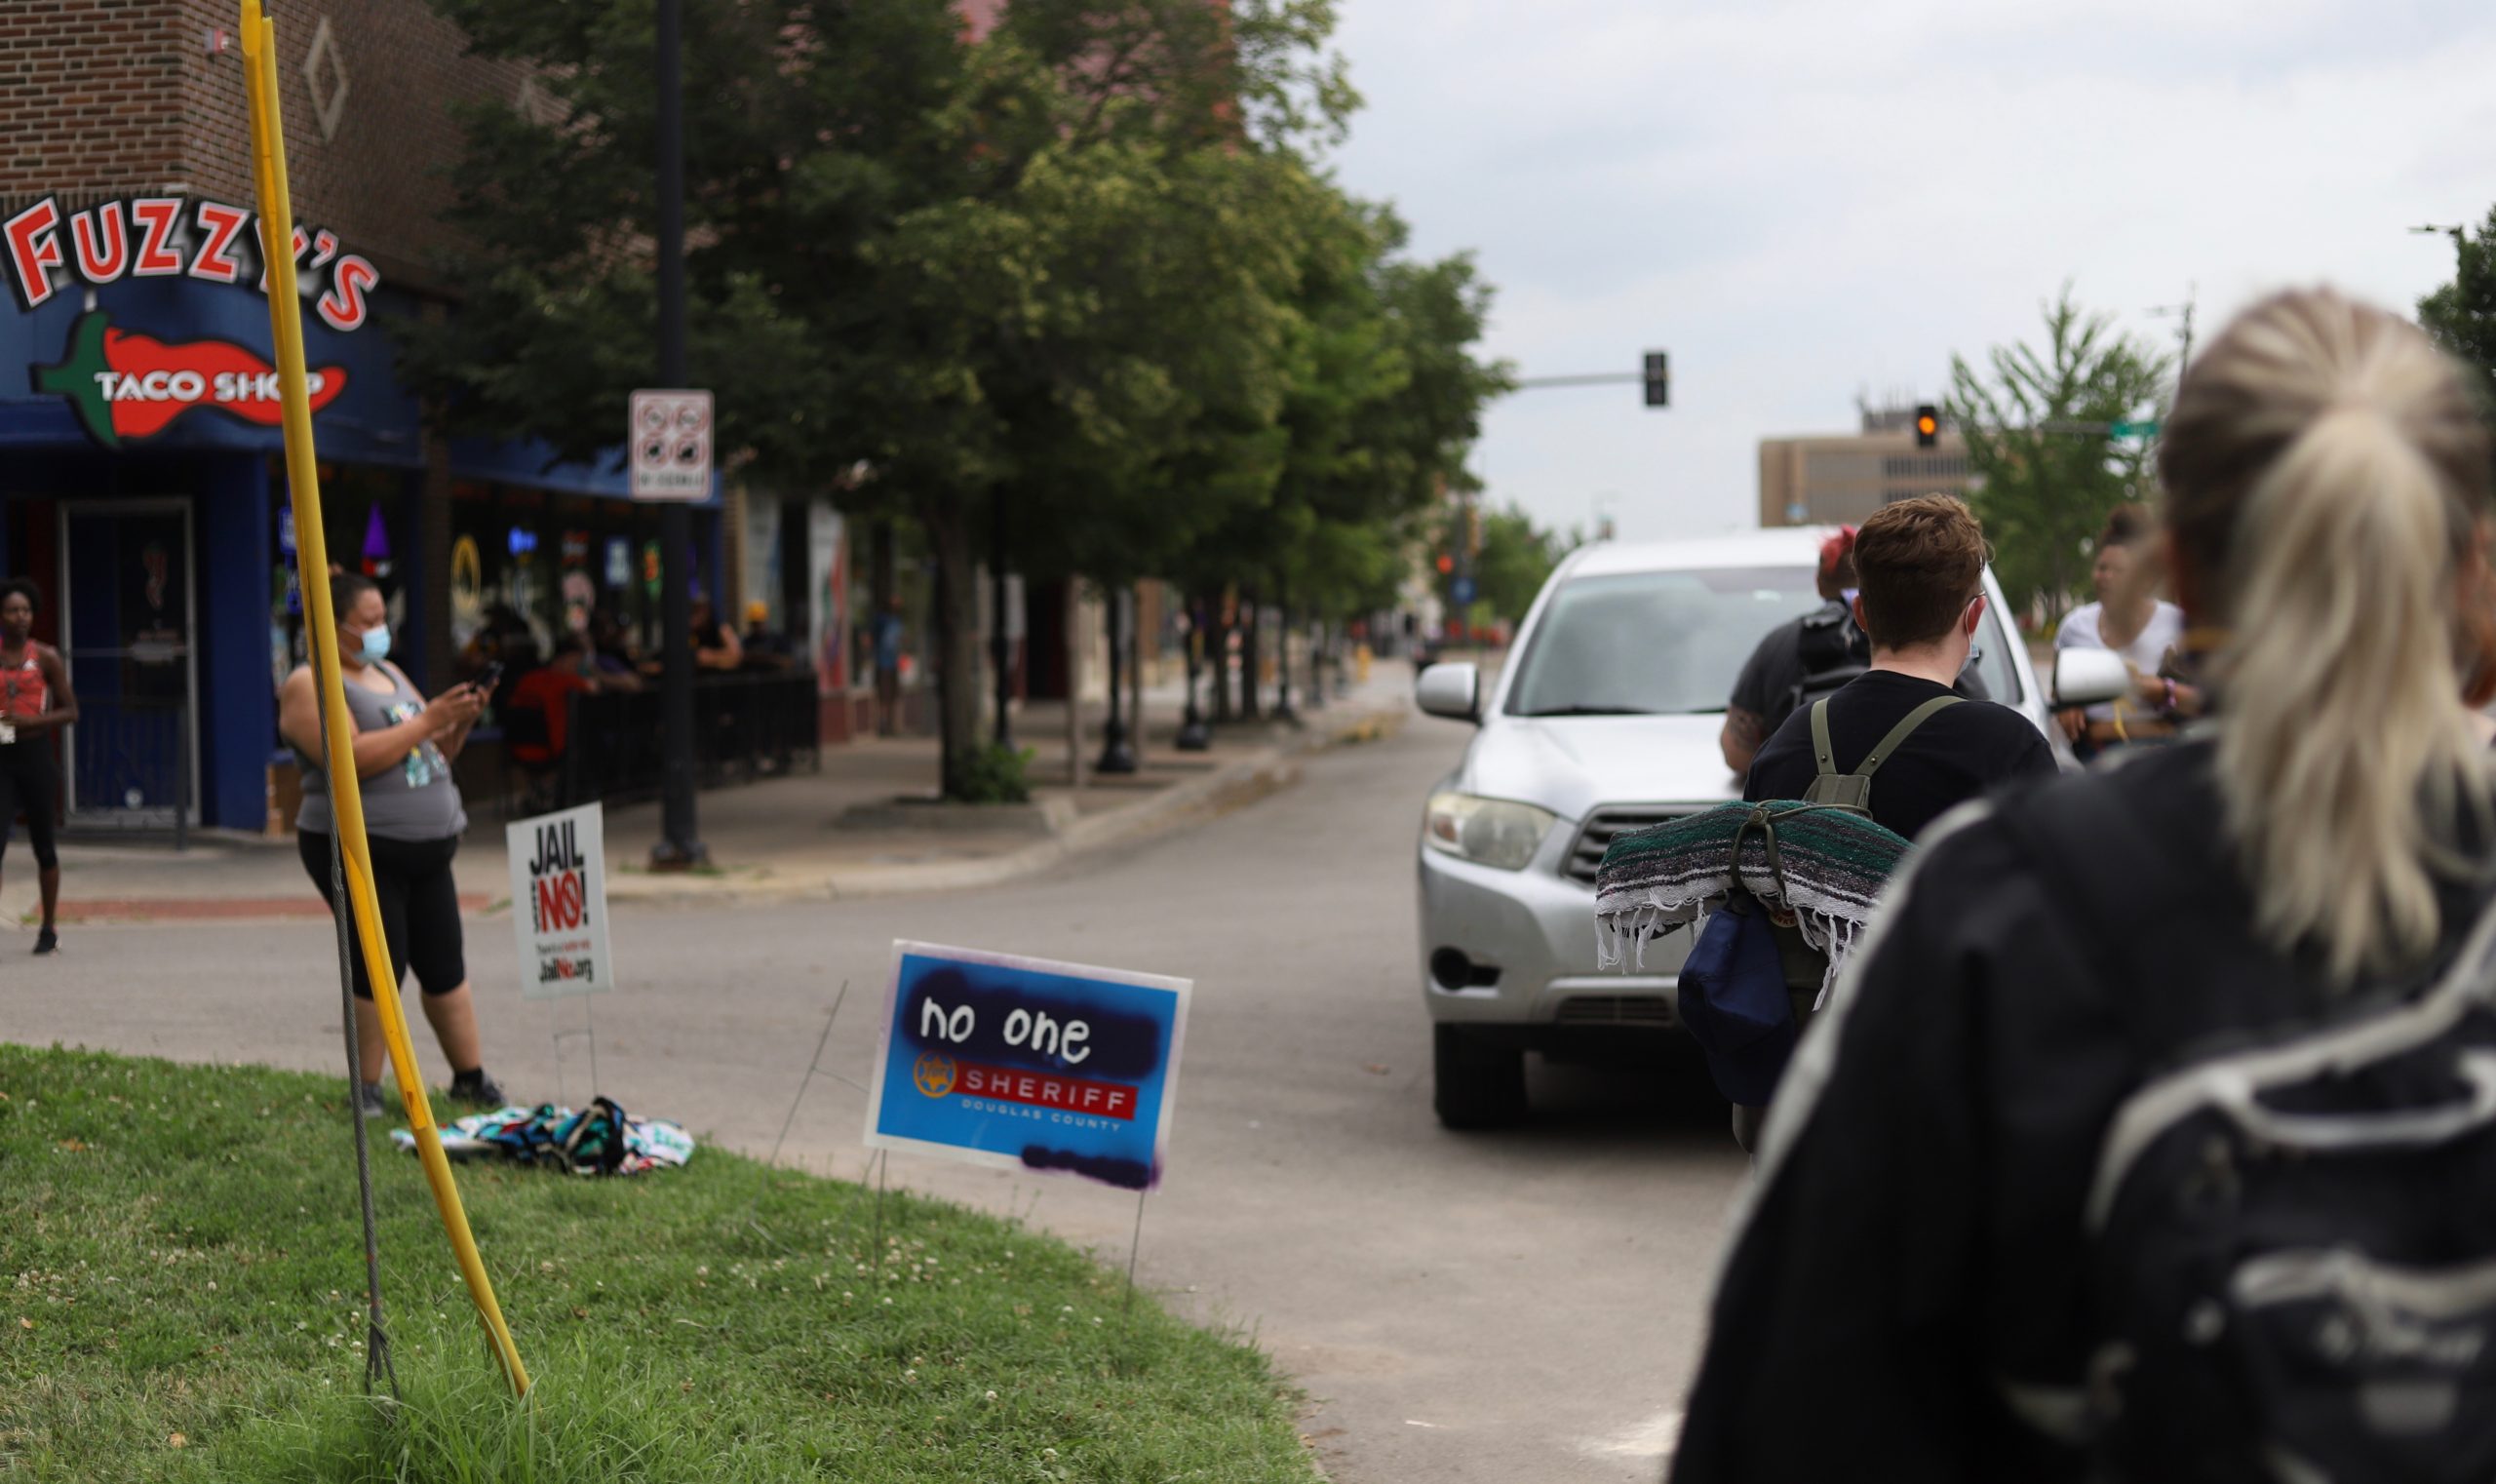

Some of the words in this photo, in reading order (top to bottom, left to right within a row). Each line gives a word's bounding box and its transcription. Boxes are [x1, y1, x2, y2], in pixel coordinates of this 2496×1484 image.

[94, 370, 206, 402] TACO
[529, 819, 584, 876] JAIL
[920, 996, 975, 1043] no
[1003, 1008, 1091, 1064] one
[965, 1070, 1125, 1112] SHERIFF
[961, 1098, 1042, 1119] DOUGLAS
[1051, 1112, 1120, 1132] COUNTY
